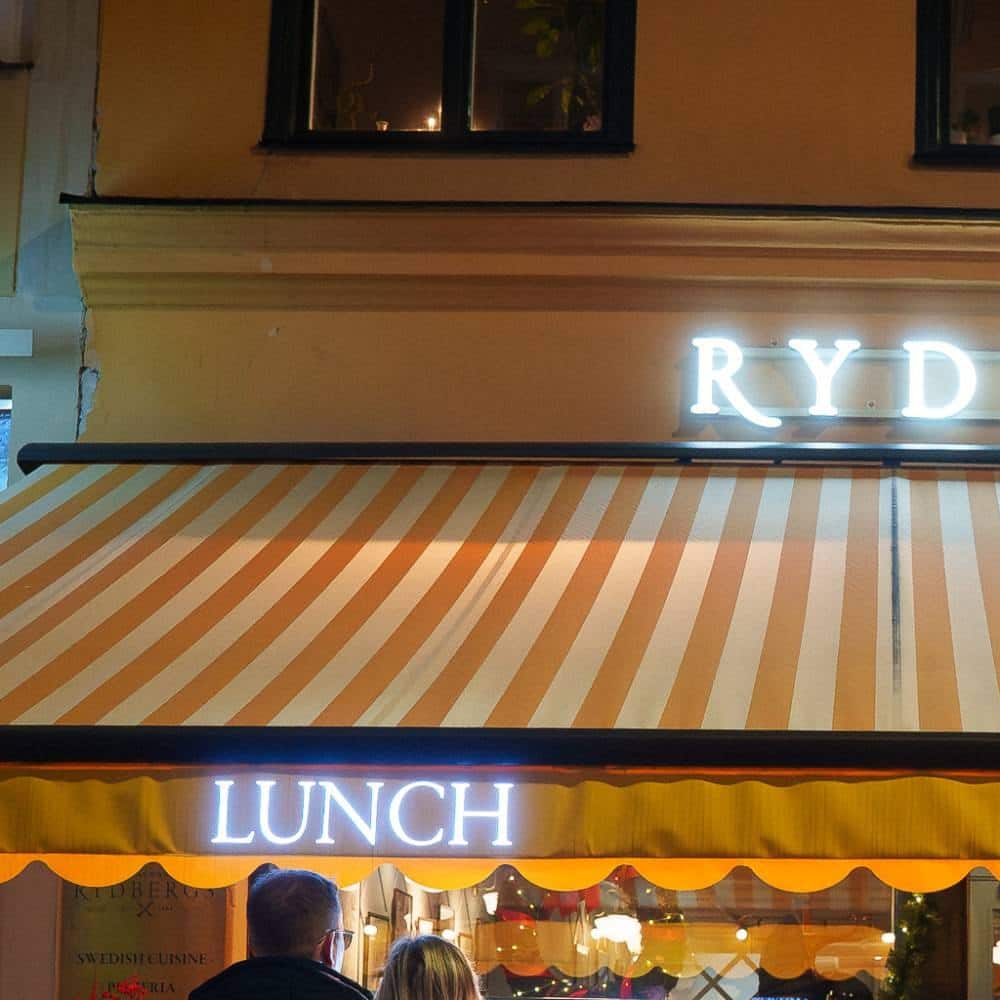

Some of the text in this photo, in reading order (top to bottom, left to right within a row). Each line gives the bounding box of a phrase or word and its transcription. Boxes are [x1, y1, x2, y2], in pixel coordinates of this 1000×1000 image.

[210, 779, 514, 847] LUNCH
[77, 952, 208, 966] SWEDISH CUISINE
